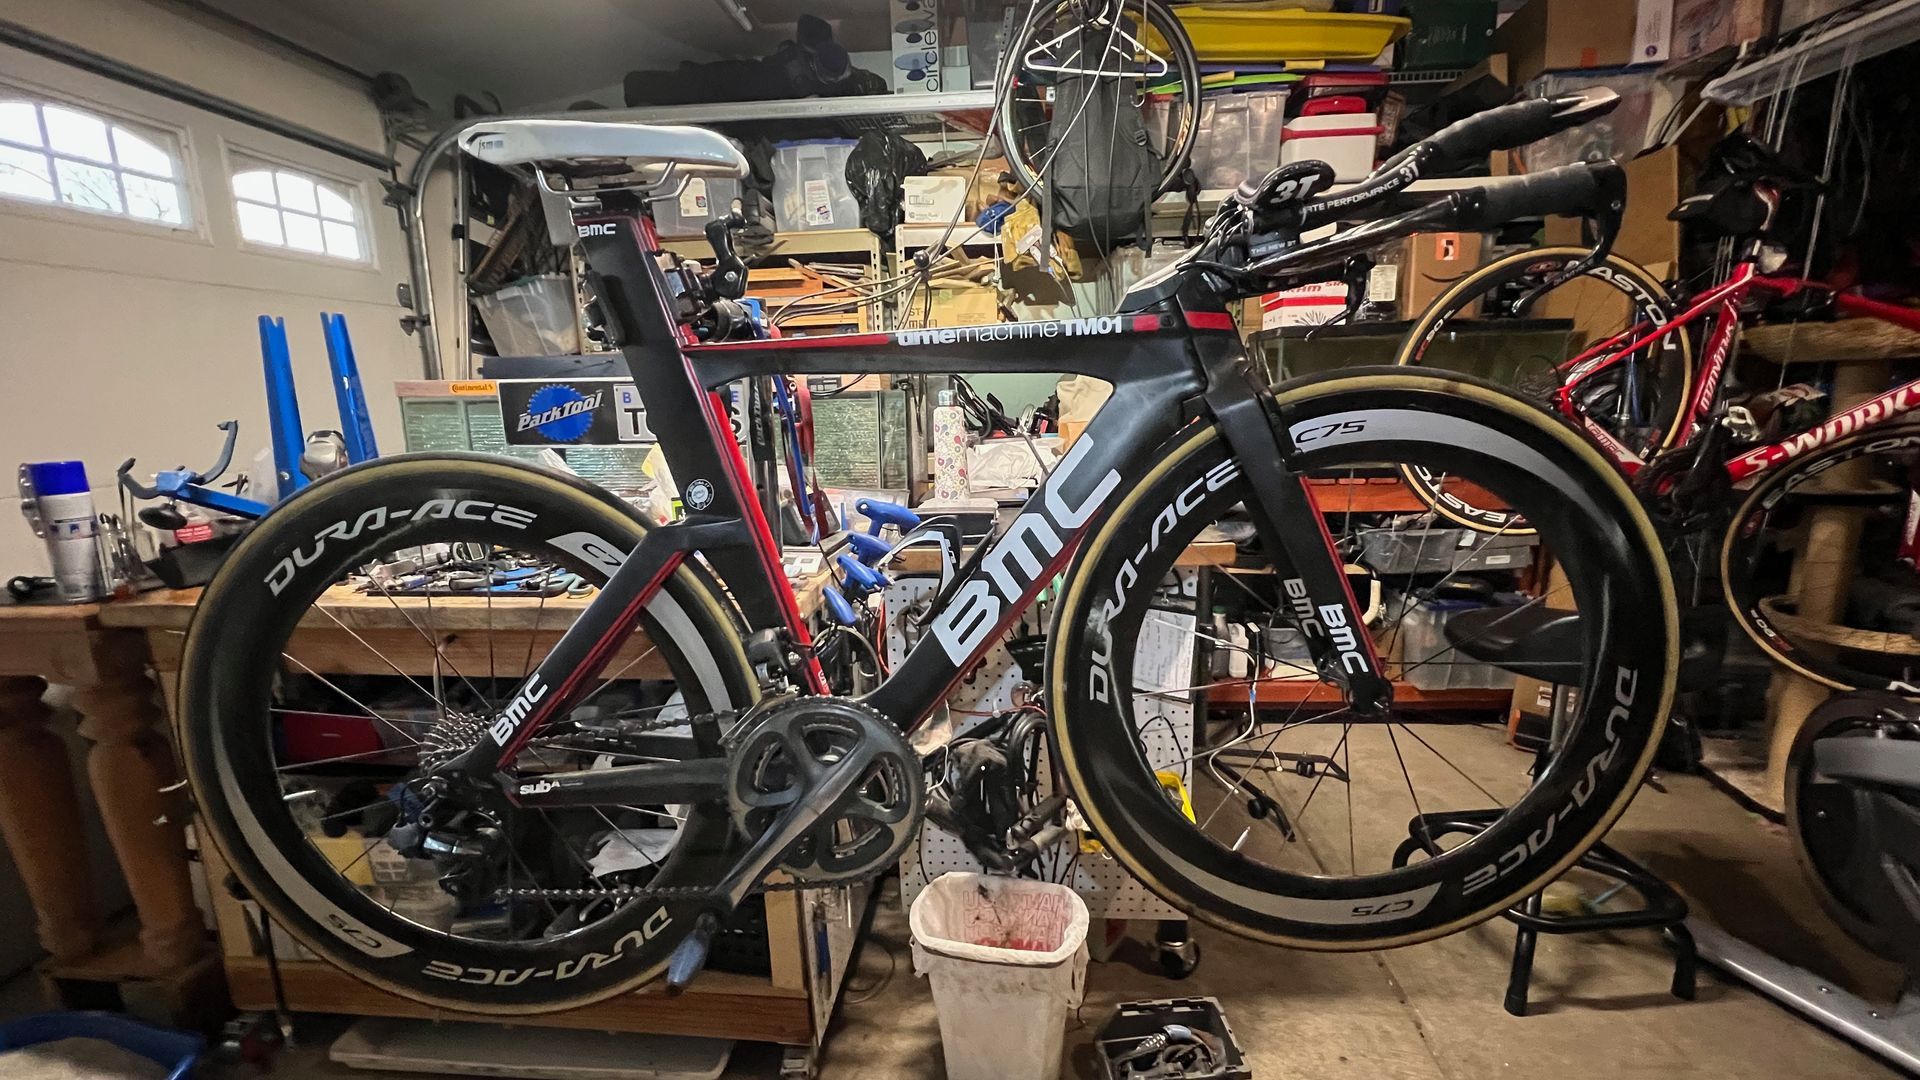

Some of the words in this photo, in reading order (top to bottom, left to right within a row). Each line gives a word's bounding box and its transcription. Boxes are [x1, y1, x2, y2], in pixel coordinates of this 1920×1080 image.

[1270, 174, 1320, 204] 3T
[1326, 177, 1400, 209] PERFORMANCE
[1400, 161, 1420, 183] 3T
[577, 222, 616, 238] BMC
[1060, 315, 1122, 337] TM01
[451, 383, 487, 393] Continental
[1295, 419, 1367, 444] C75
[263, 499, 538, 597] DURA-ACE
[582, 542, 623, 567] C7
[930, 432, 1122, 668] BMC
[1089, 458, 1243, 704] DURA-ACE
[1283, 578, 1325, 639] BMC
[1318, 603, 1369, 674] BMC
[488, 672, 549, 747] BMC
[1462, 666, 1638, 896] DURA-ACE
[328, 913, 382, 949] C75
[1351, 900, 1414, 918] C75
[421, 905, 673, 986] DURA-ACE
